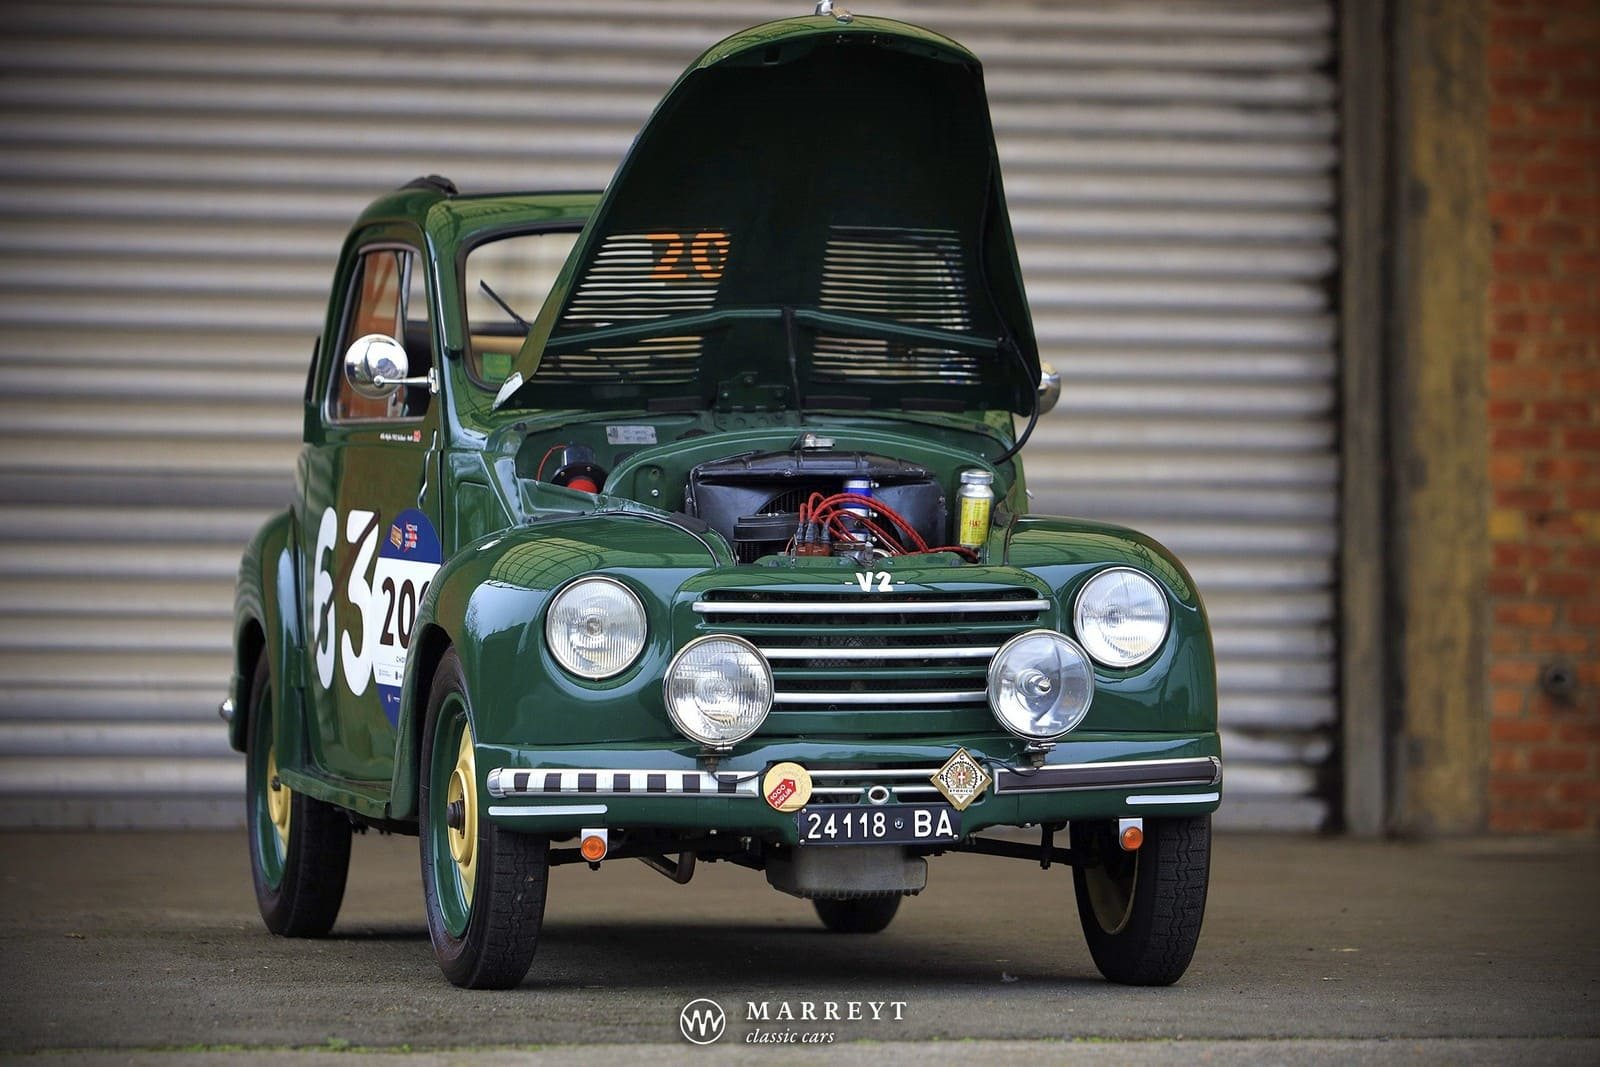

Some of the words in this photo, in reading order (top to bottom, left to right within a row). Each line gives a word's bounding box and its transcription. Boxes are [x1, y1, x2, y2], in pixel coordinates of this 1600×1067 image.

[380, 576, 430, 650] 20
[770, 784, 786, 801] 1000
[774, 788, 793, 807] MIGLIA
[807, 811, 886, 839] 24118
[914, 809, 953, 838] BA
